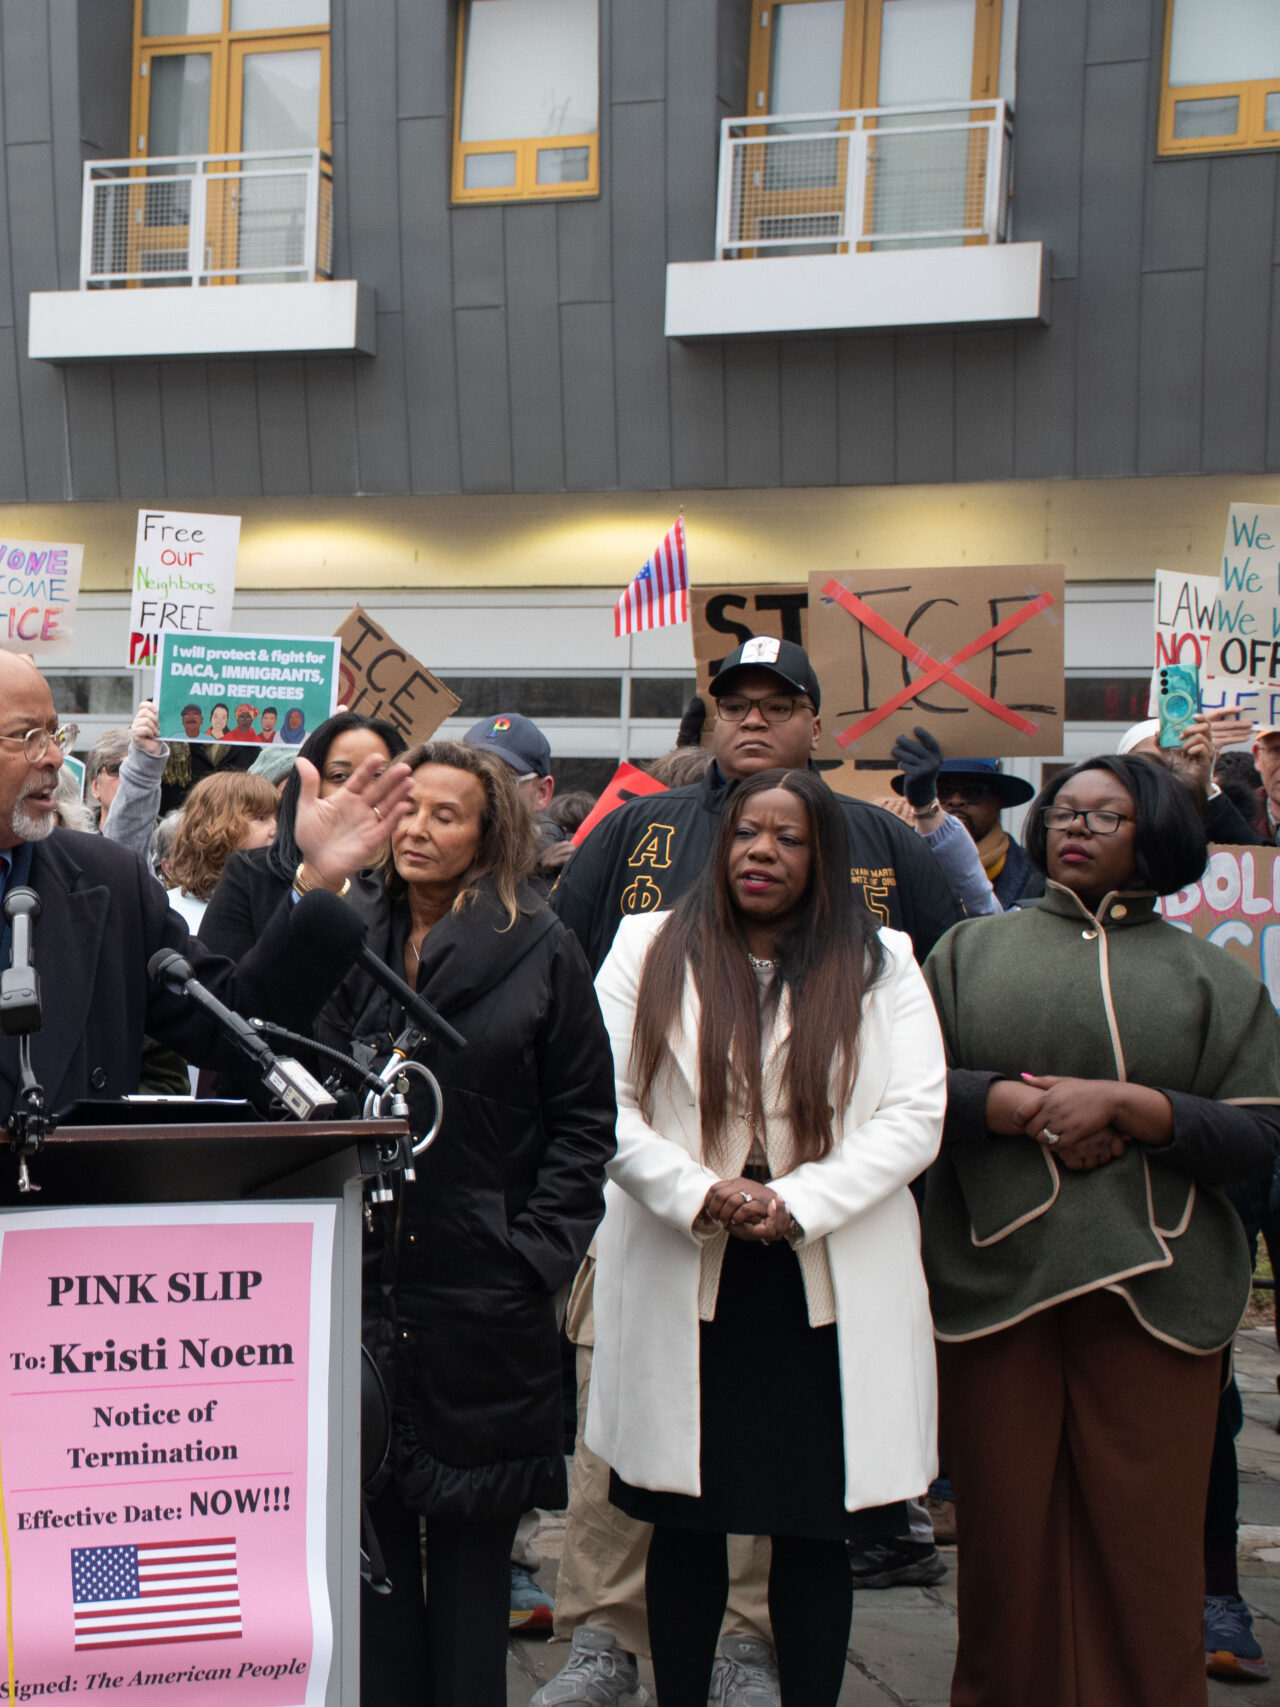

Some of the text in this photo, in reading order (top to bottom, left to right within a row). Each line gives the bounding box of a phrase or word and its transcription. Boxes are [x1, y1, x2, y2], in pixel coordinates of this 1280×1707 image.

[144, 514, 206, 543] Free
[1232, 515, 1274, 549] We
[137, 566, 216, 599] Neighbors
[1224, 557, 1263, 592] We
[8, 606, 63, 641] ICE
[140, 601, 215, 632] FREE
[706, 593, 808, 650] ST
[1158, 582, 1217, 631] LAW
[1218, 600, 1258, 635] We
[129, 632, 158, 666] PA
[173, 645, 326, 664] I will protect & fight for
[820, 586, 1058, 717] ICE
[171, 663, 325, 685] DACA, IMMIGRANTS,
[341, 615, 438, 725] ICE
[190, 682, 304, 700] AND REFUGEES
[488, 718, 511, 738] P
[47, 1270, 263, 1307] PINK SLIP
[10, 1337, 294, 1375] To: Kristi Noem
[93, 1400, 219, 1428] Notice of
[67, 1440, 238, 1469] Termination
[17, 1486, 291, 1531] Effective Date: NOW!!!
[85, 1673, 124, 1691] The
[129, 1663, 234, 1687] American
[237, 1657, 307, 1680] People
